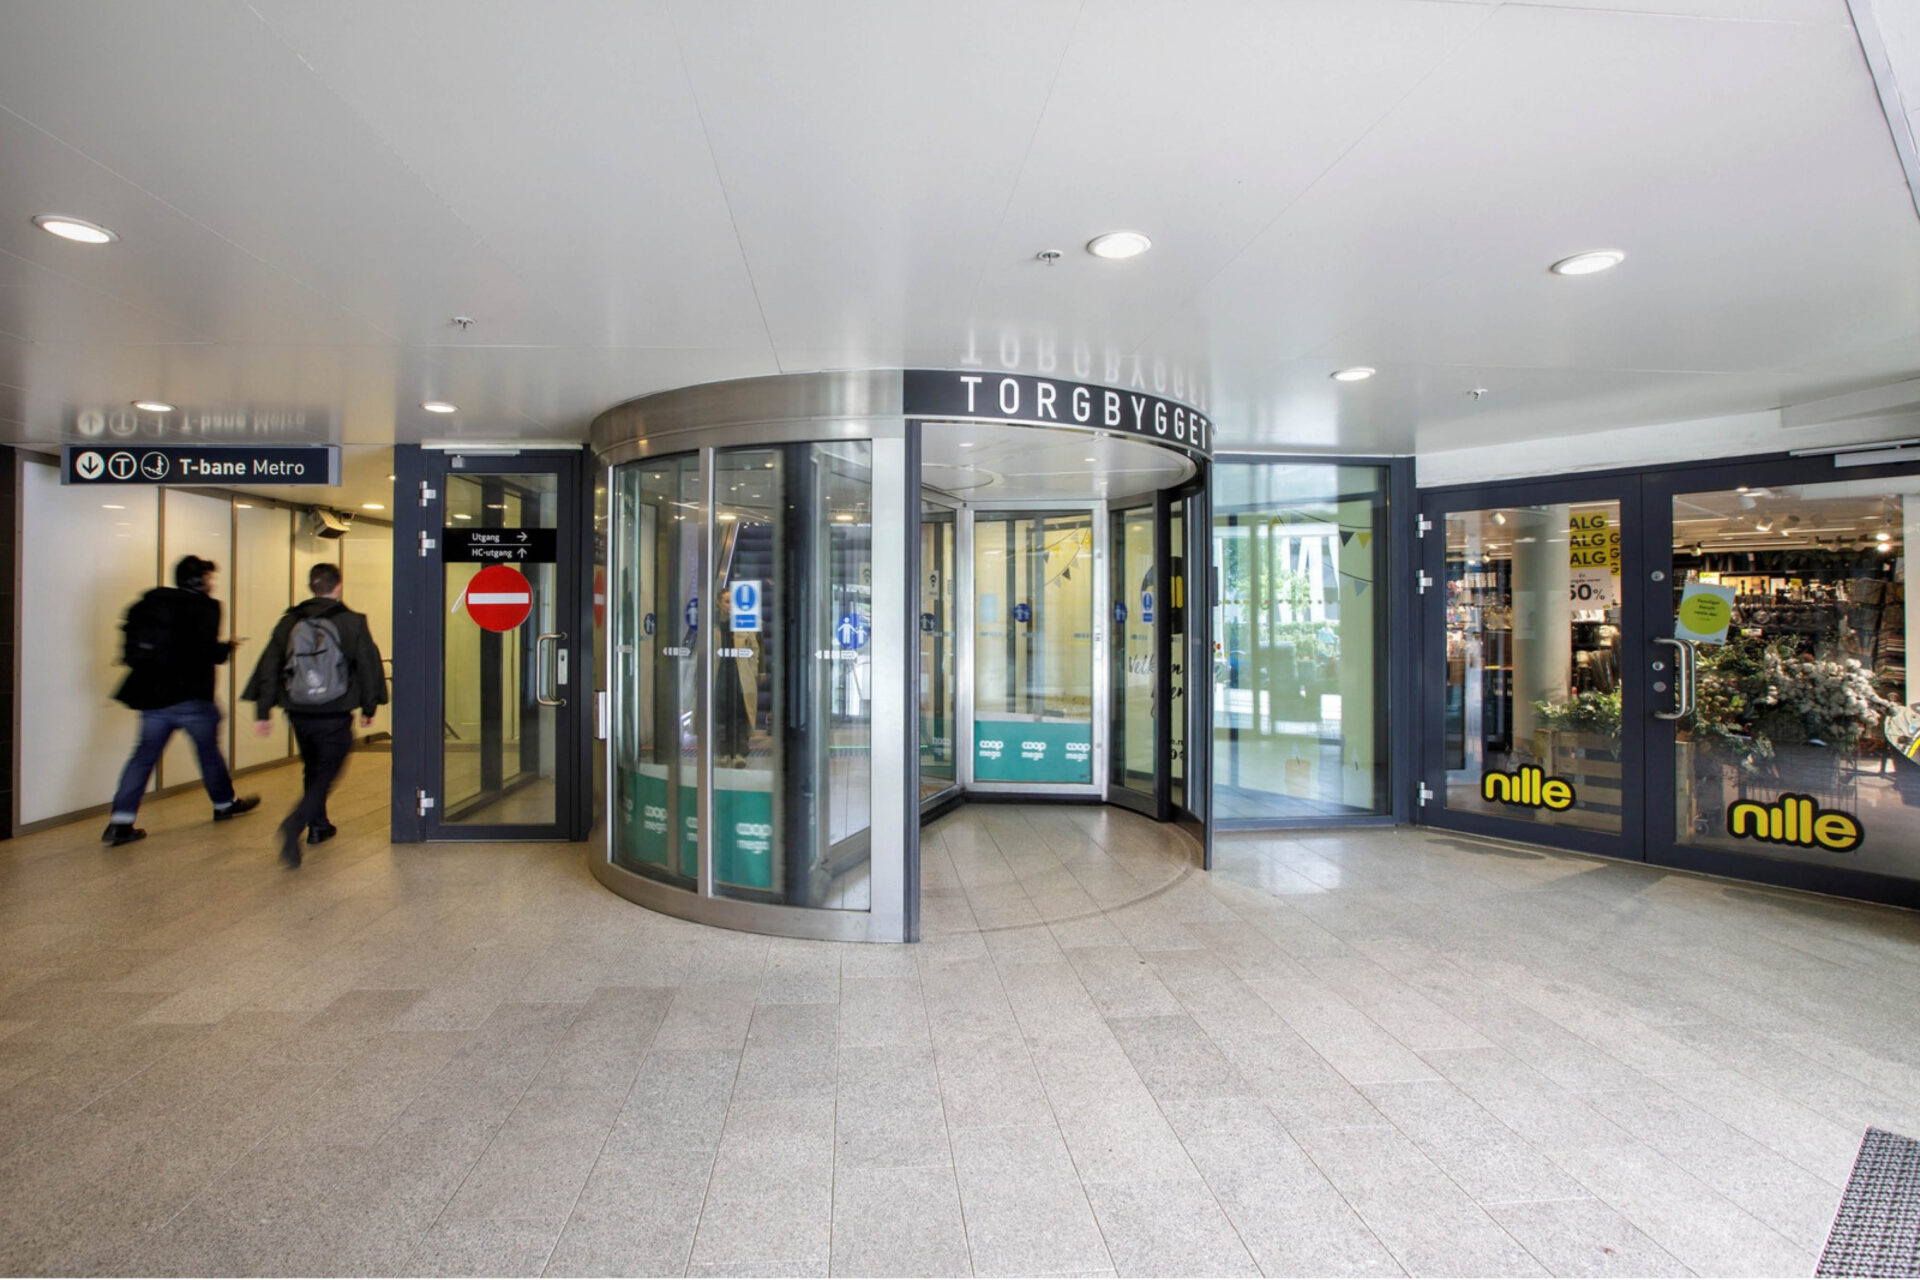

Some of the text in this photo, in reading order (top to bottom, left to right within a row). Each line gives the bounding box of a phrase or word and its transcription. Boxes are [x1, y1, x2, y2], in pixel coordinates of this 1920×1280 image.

[960, 376, 1207, 449] TORGBYGGET
[179, 458, 246, 475] T-bane
[253, 459, 305, 475] Metro
[1569, 515, 1605, 529] ALG
[472, 532, 500, 543] Utgang
[1569, 533, 1606, 548] ALG
[472, 548, 512, 558] HC-utgang
[1569, 551, 1607, 565] ALG
[1485, 767, 1572, 809] nille
[1732, 797, 1857, 848] nille
